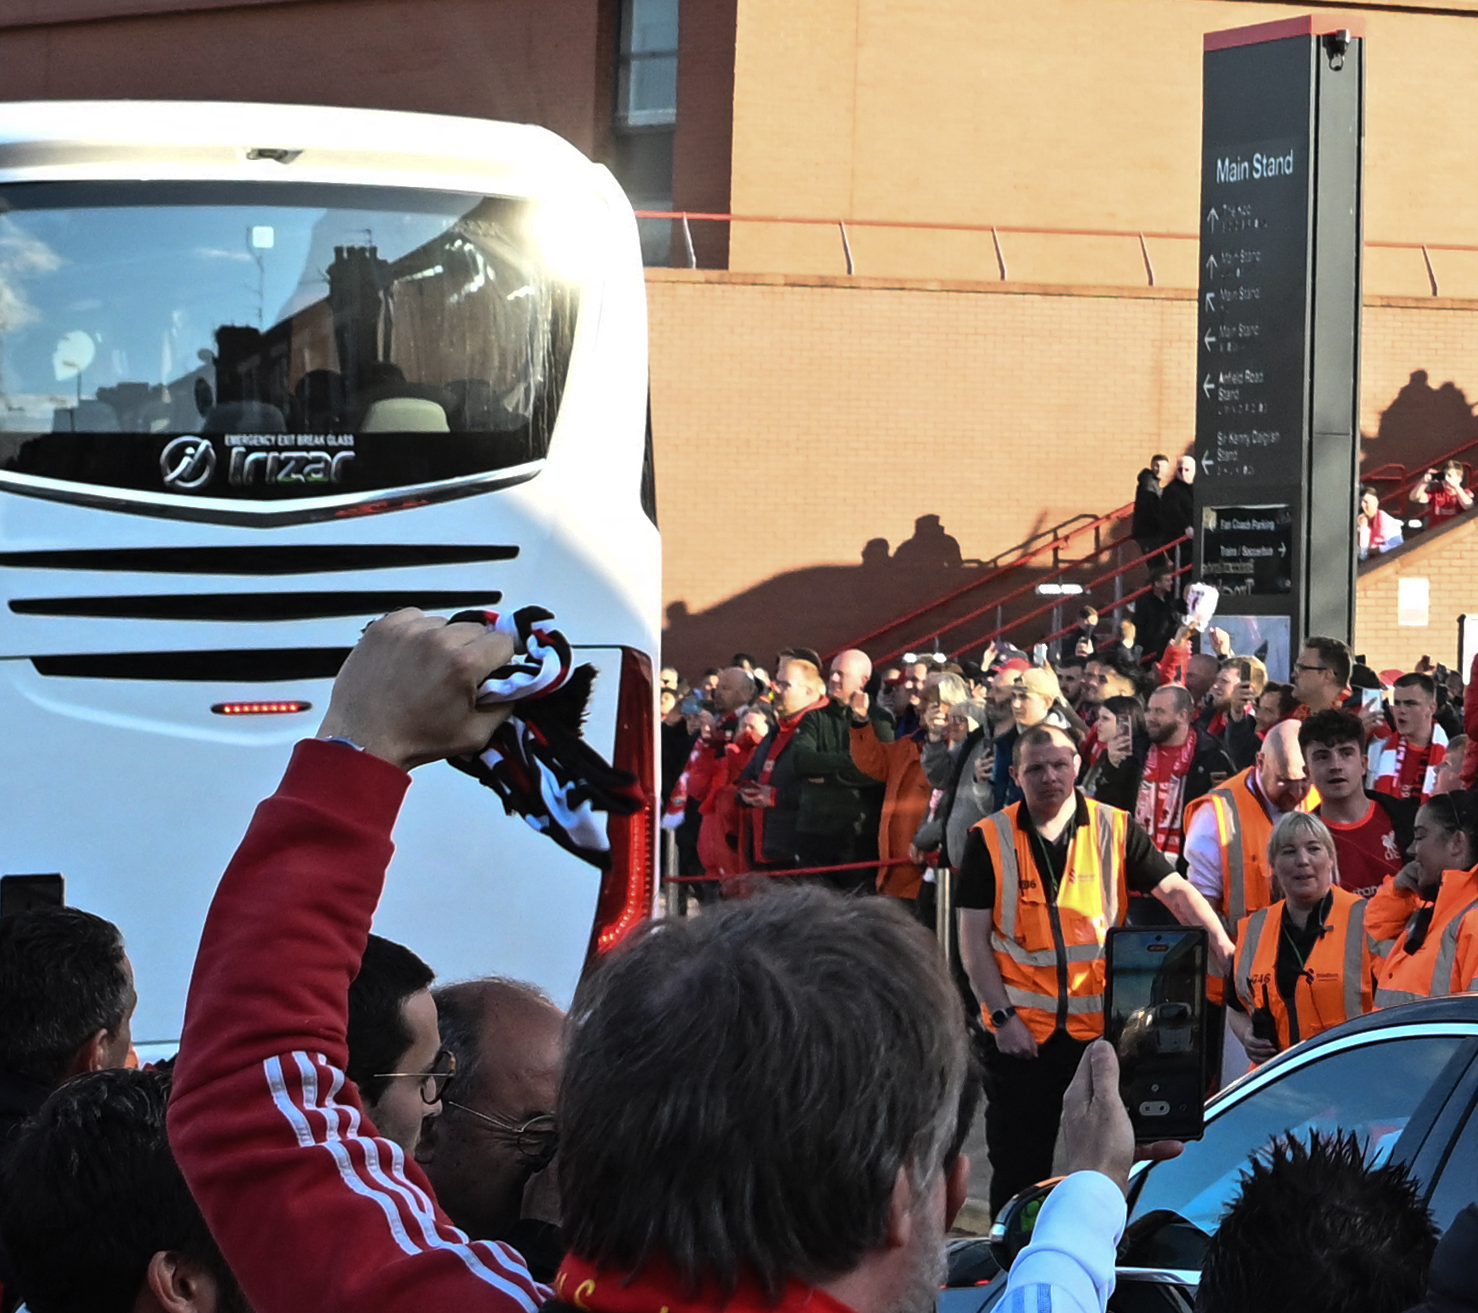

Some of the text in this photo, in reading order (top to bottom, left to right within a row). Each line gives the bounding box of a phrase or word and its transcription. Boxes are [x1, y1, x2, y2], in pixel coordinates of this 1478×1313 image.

[1216, 149, 1294, 184] Main Stand
[224, 434, 276, 446] EMERGENCY
[277, 434, 296, 446] EXIT
[326, 434, 354, 446] GLASS
[1251, 518, 1275, 531] Parking
